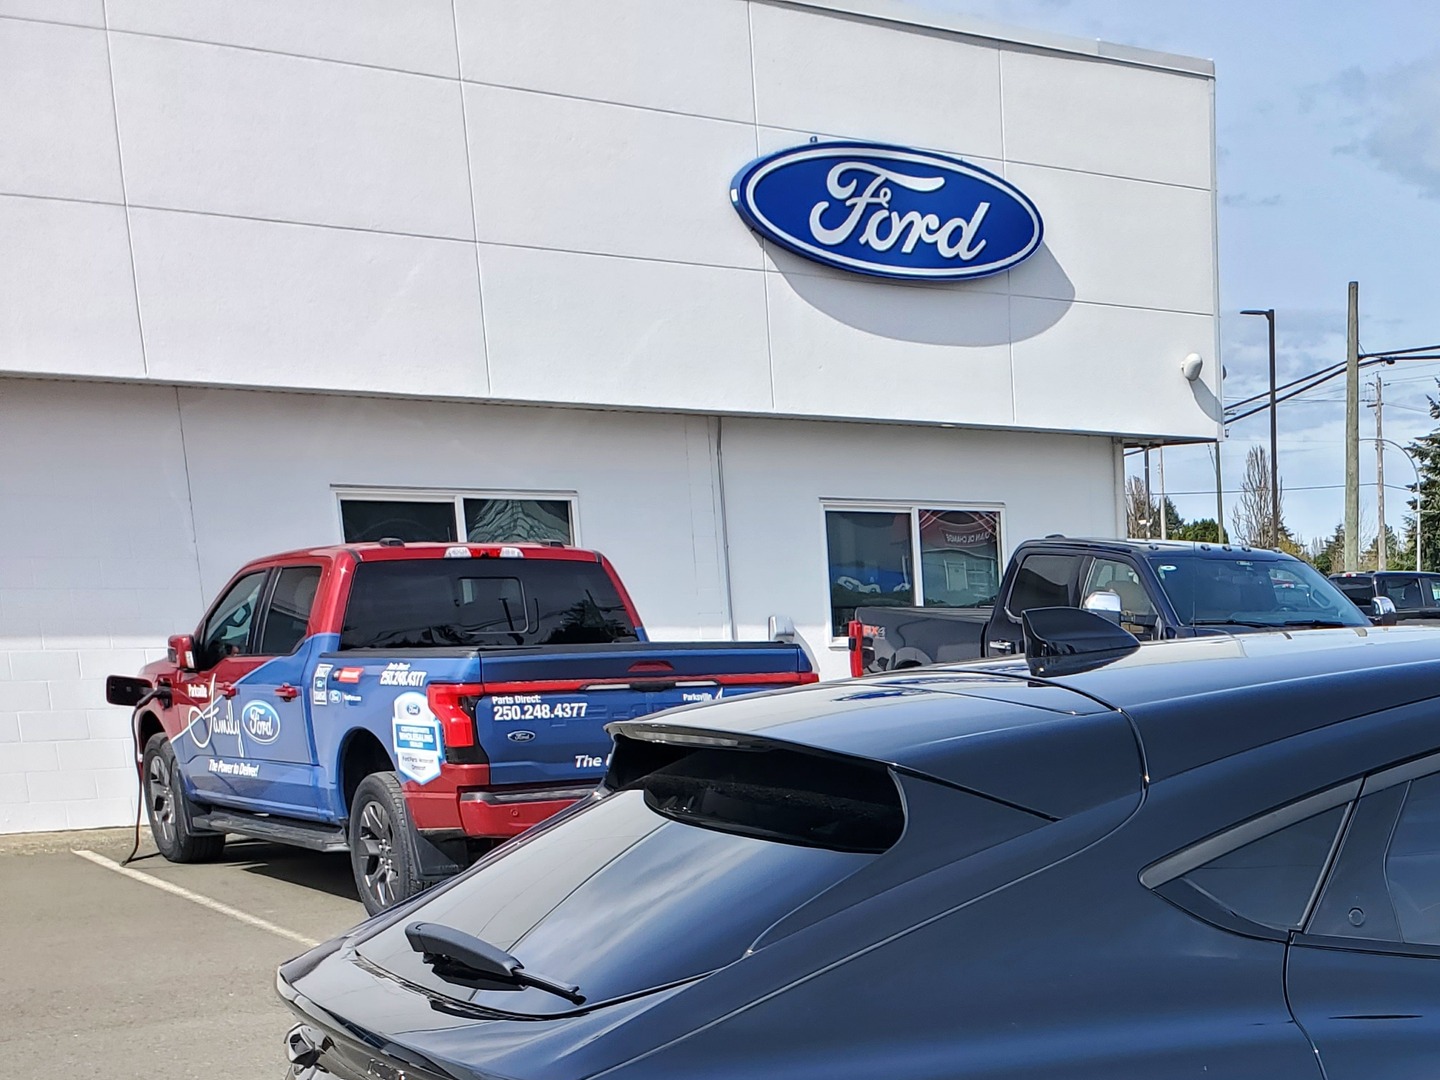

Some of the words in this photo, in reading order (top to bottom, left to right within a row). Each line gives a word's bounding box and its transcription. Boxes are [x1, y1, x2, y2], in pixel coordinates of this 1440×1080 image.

[809, 161, 990, 260] Ford
[492, 696, 514, 704] Parts
[514, 695, 541, 704] Direct:
[188, 673, 245, 758] Family
[250, 706, 273, 736] Ford
[494, 703, 588, 720] 250.248.4377
[575, 754, 602, 768] The
